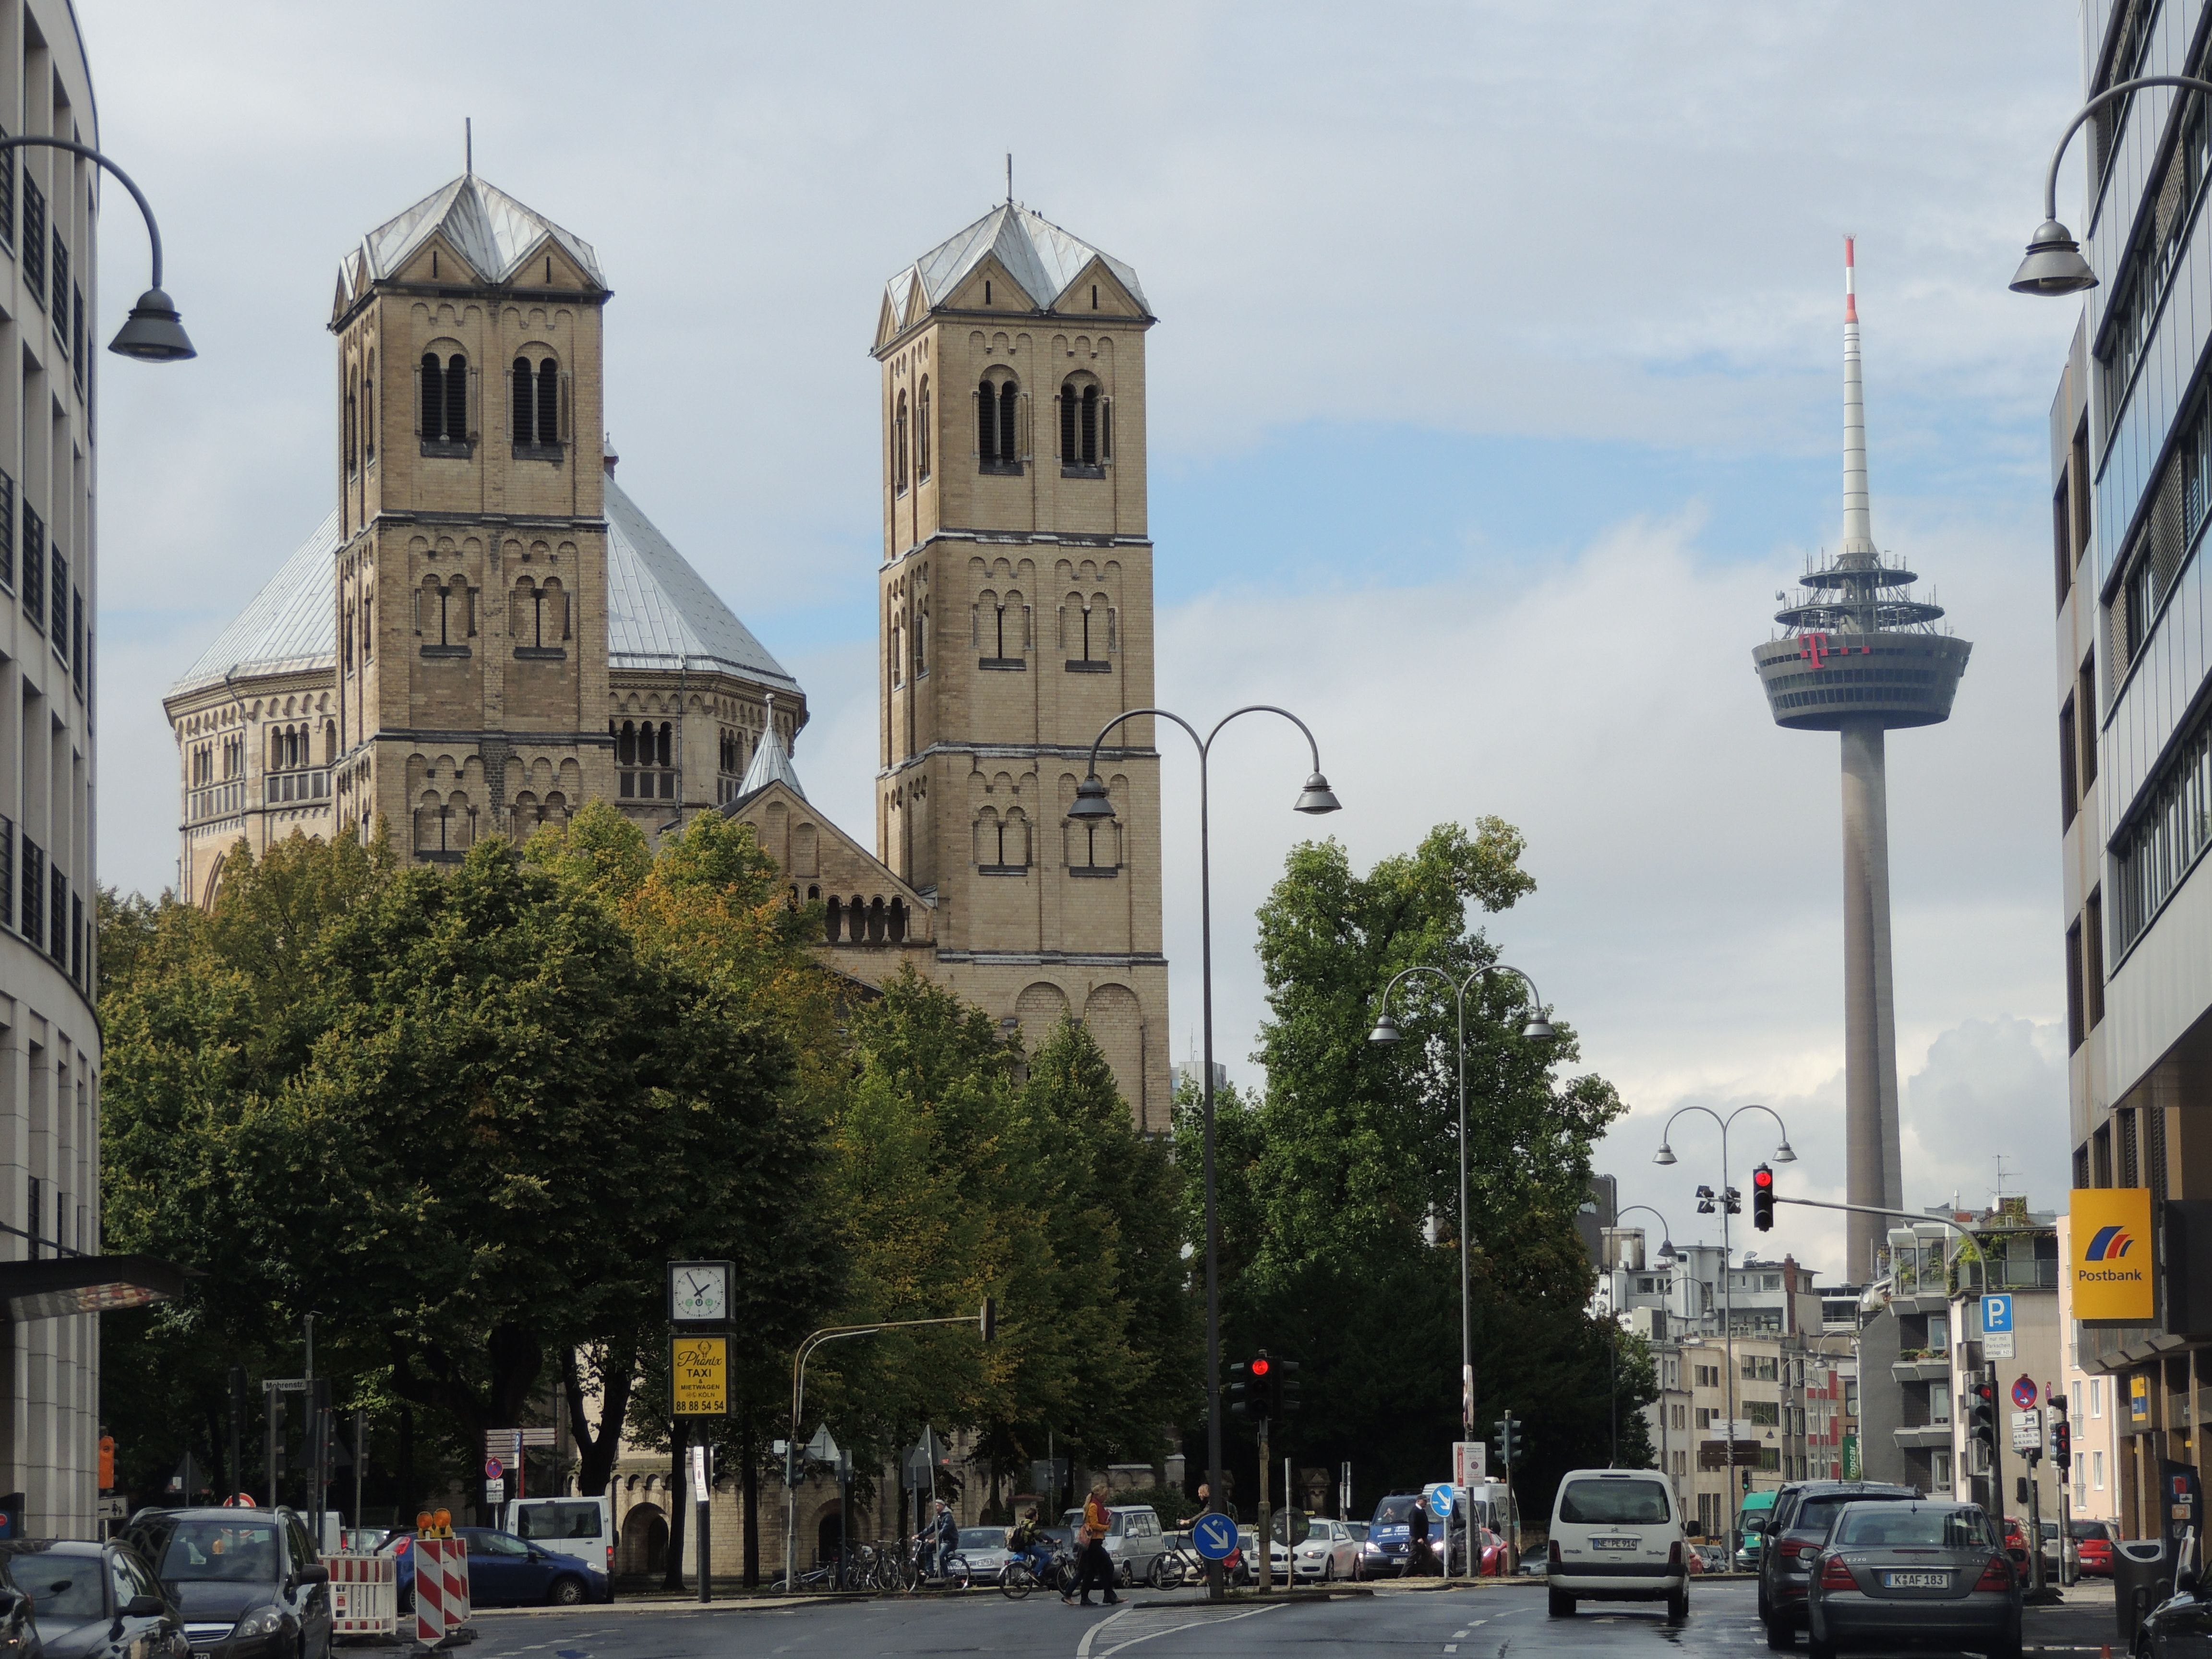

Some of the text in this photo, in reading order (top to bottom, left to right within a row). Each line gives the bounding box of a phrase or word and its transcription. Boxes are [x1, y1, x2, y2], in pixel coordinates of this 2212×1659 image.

[2079, 1268, 2142, 1281] Postbank
[1988, 1298, 2005, 1327] P
[686, 1369, 711, 1378] TAXI
[676, 1400, 724, 1411] 88 88 54 54
[1894, 1575, 1943, 1585] K AF 183
